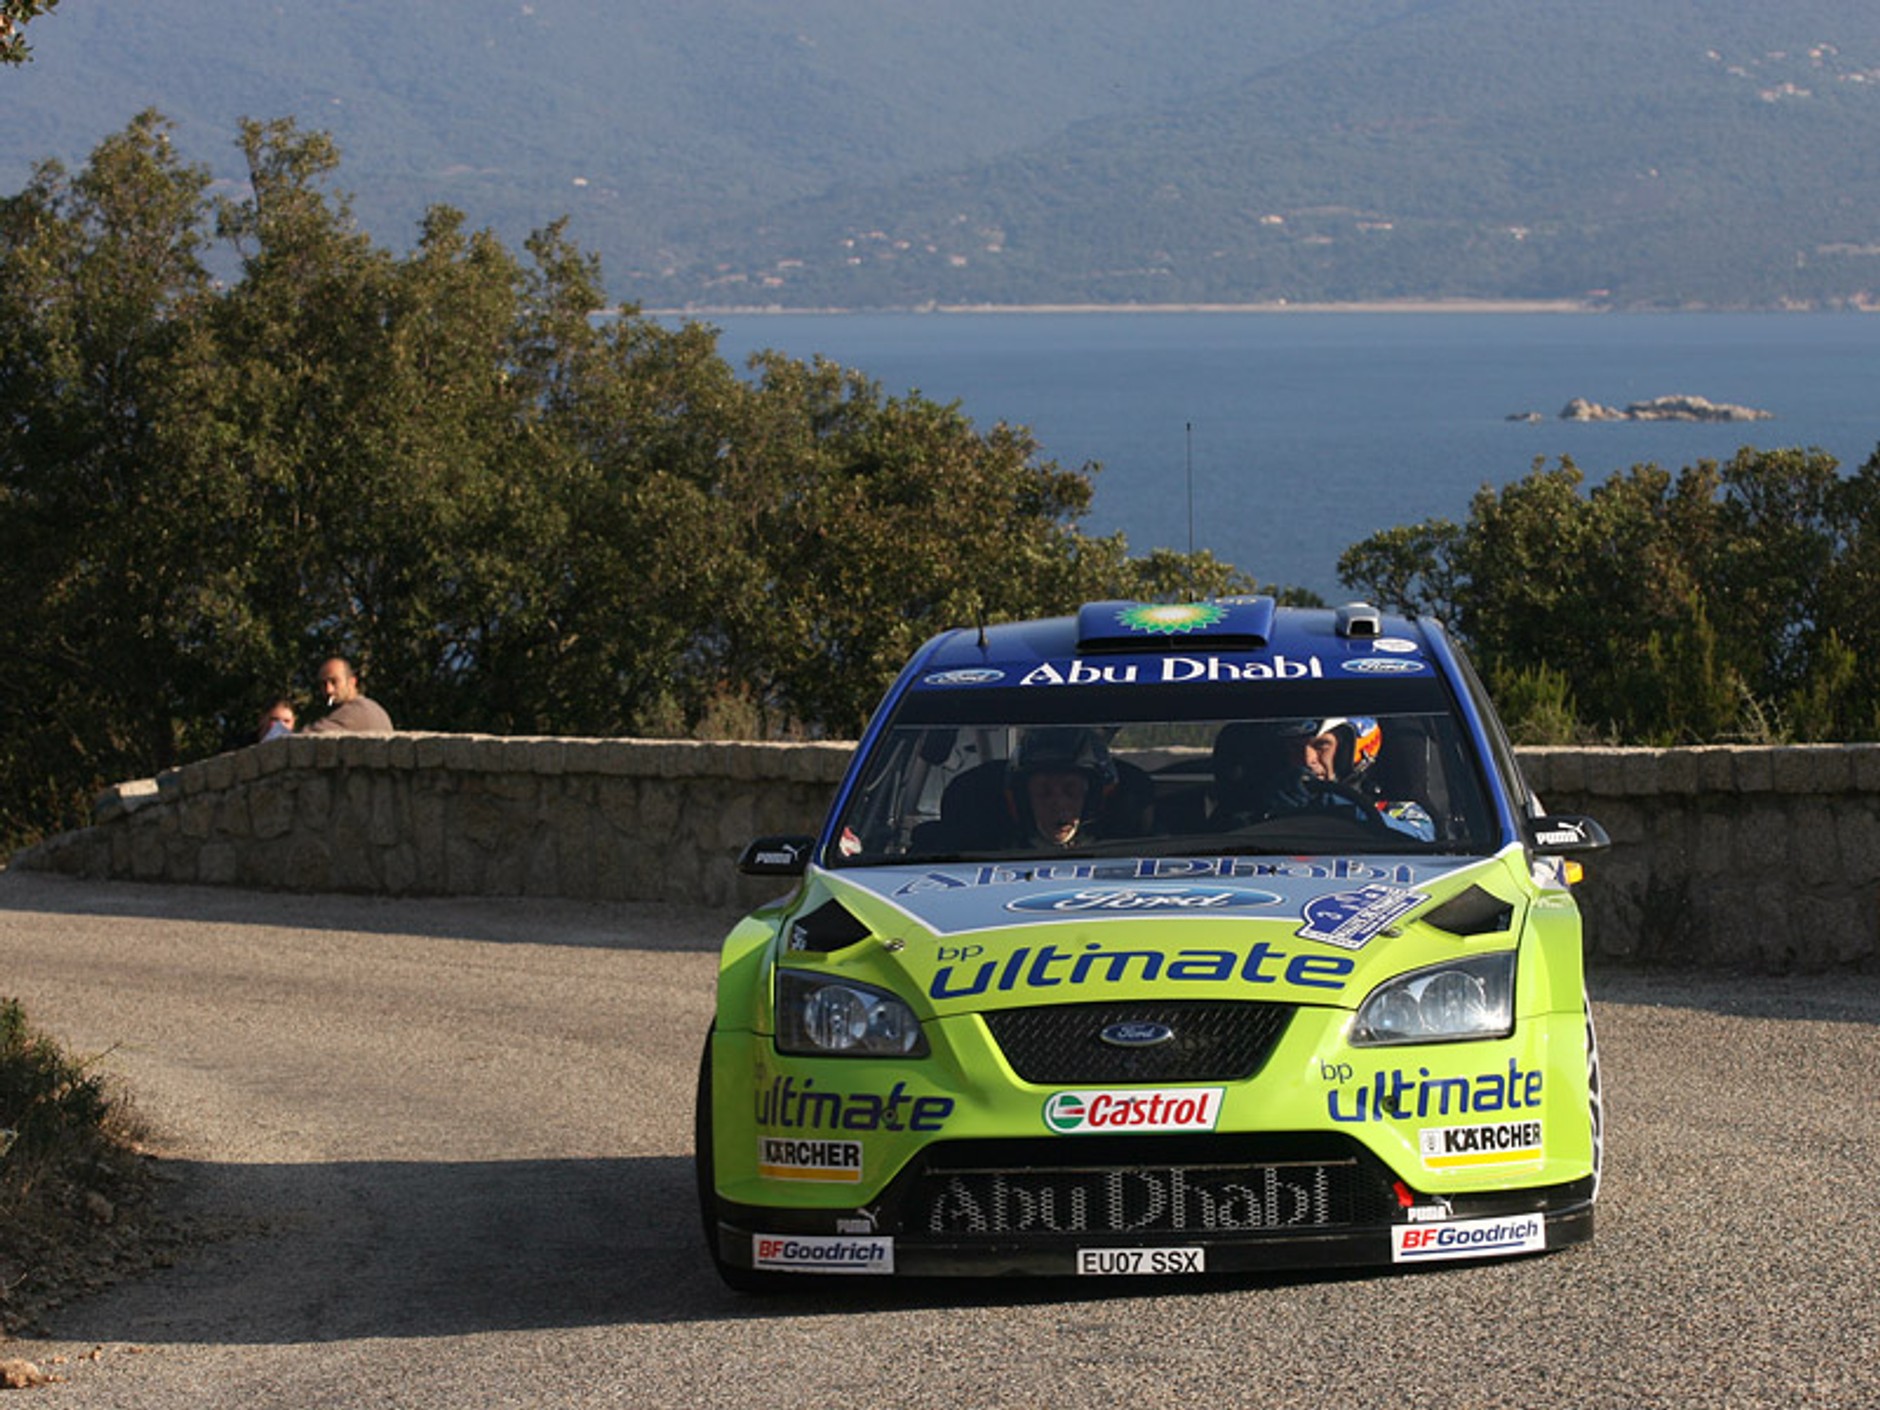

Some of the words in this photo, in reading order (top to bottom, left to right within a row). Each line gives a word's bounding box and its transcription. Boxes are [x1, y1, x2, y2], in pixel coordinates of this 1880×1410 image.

[1020, 660, 1138, 685] Abu
[1161, 655, 1323, 682] Dhabi
[1535, 831, 1579, 845] PUMA
[893, 866, 1095, 896] Abu
[1133, 857, 1414, 884] Dhabi
[1053, 890, 1235, 910] Ford
[937, 945, 984, 962] bp
[930, 942, 1354, 999] ultimate
[1117, 1022, 1156, 1038] Ford
[1321, 1060, 1353, 1083] bp
[755, 1075, 955, 1131] ultimate
[1327, 1058, 1543, 1122] ultimate
[1088, 1094, 1209, 1126] Castrol
[1444, 1123, 1541, 1153] KÄRCHER
[929, 1174, 1087, 1233] Abu
[1107, 1165, 1329, 1232] Dhabi
[1407, 1206, 1447, 1223] PUMA
[1401, 1220, 1539, 1249] BFGoodrich
[758, 1240, 885, 1262] BFGoodrich
[1083, 1253, 1144, 1273] EU07
[1150, 1253, 1200, 1273] SSX
